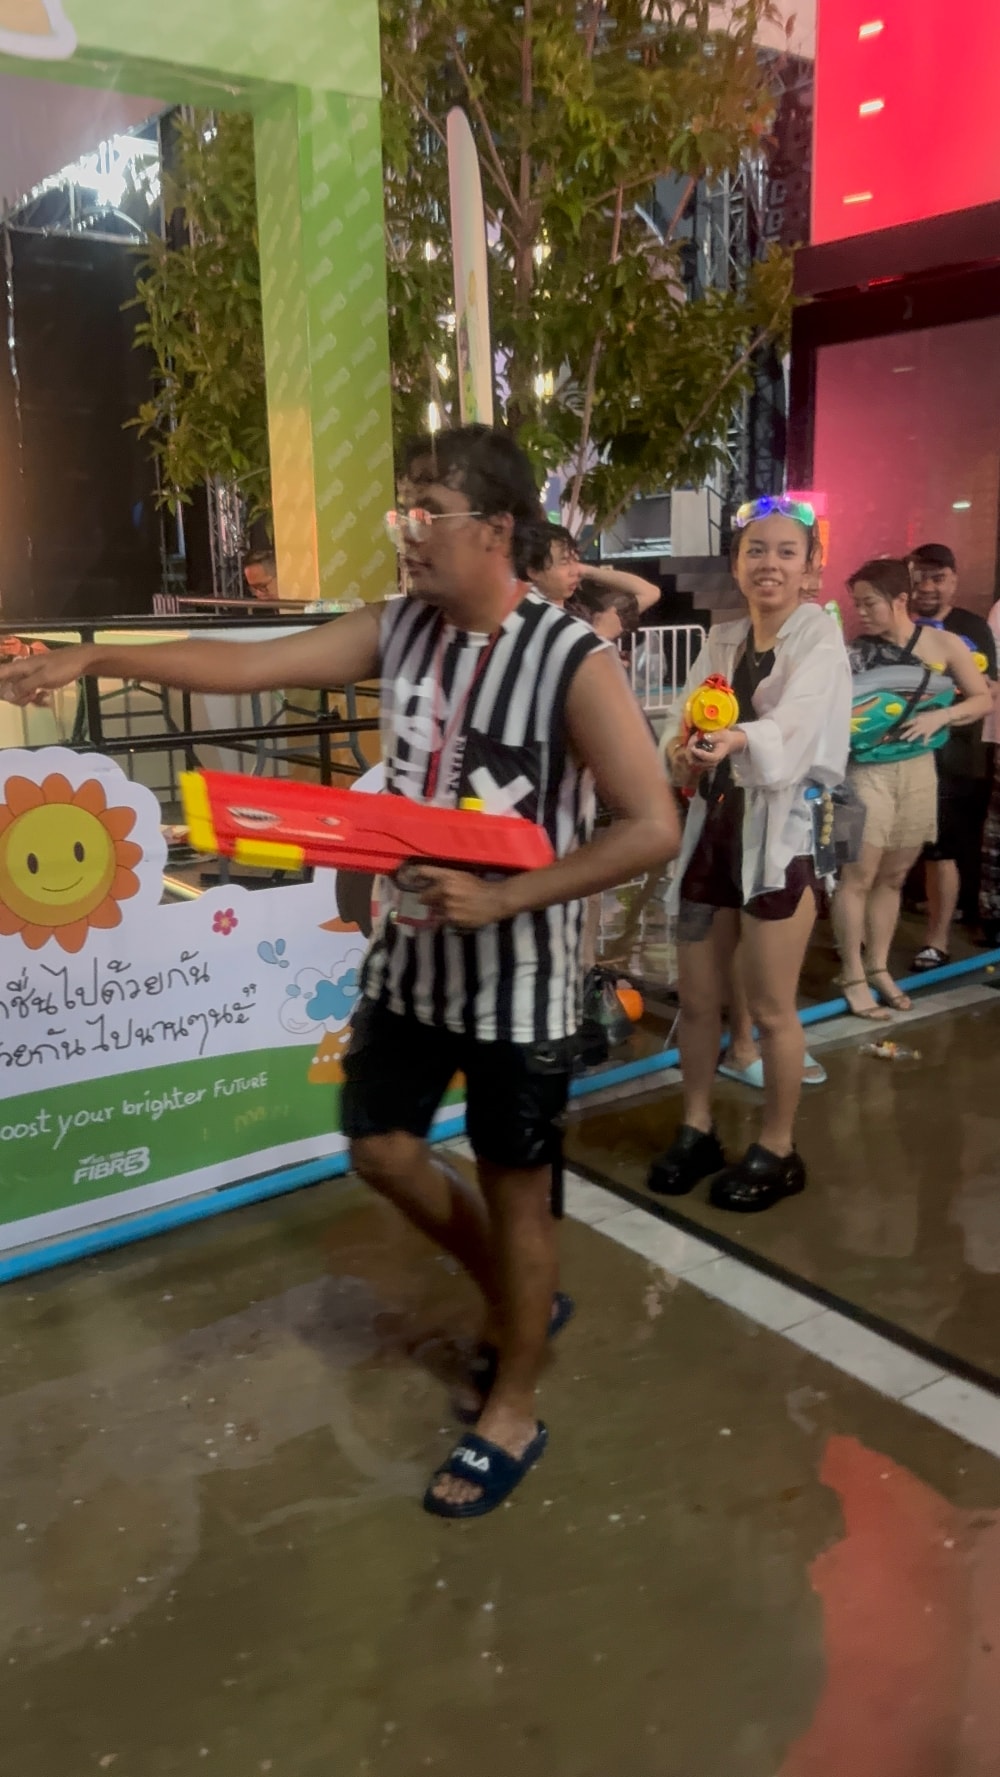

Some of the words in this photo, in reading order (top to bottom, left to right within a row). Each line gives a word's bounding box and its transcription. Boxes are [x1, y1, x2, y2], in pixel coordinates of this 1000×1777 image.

[0, 1108, 51, 1141] oost
[53, 1106, 114, 1150] your
[122, 1087, 207, 1121] brighter
[451, 1446, 490, 1472] FILA
